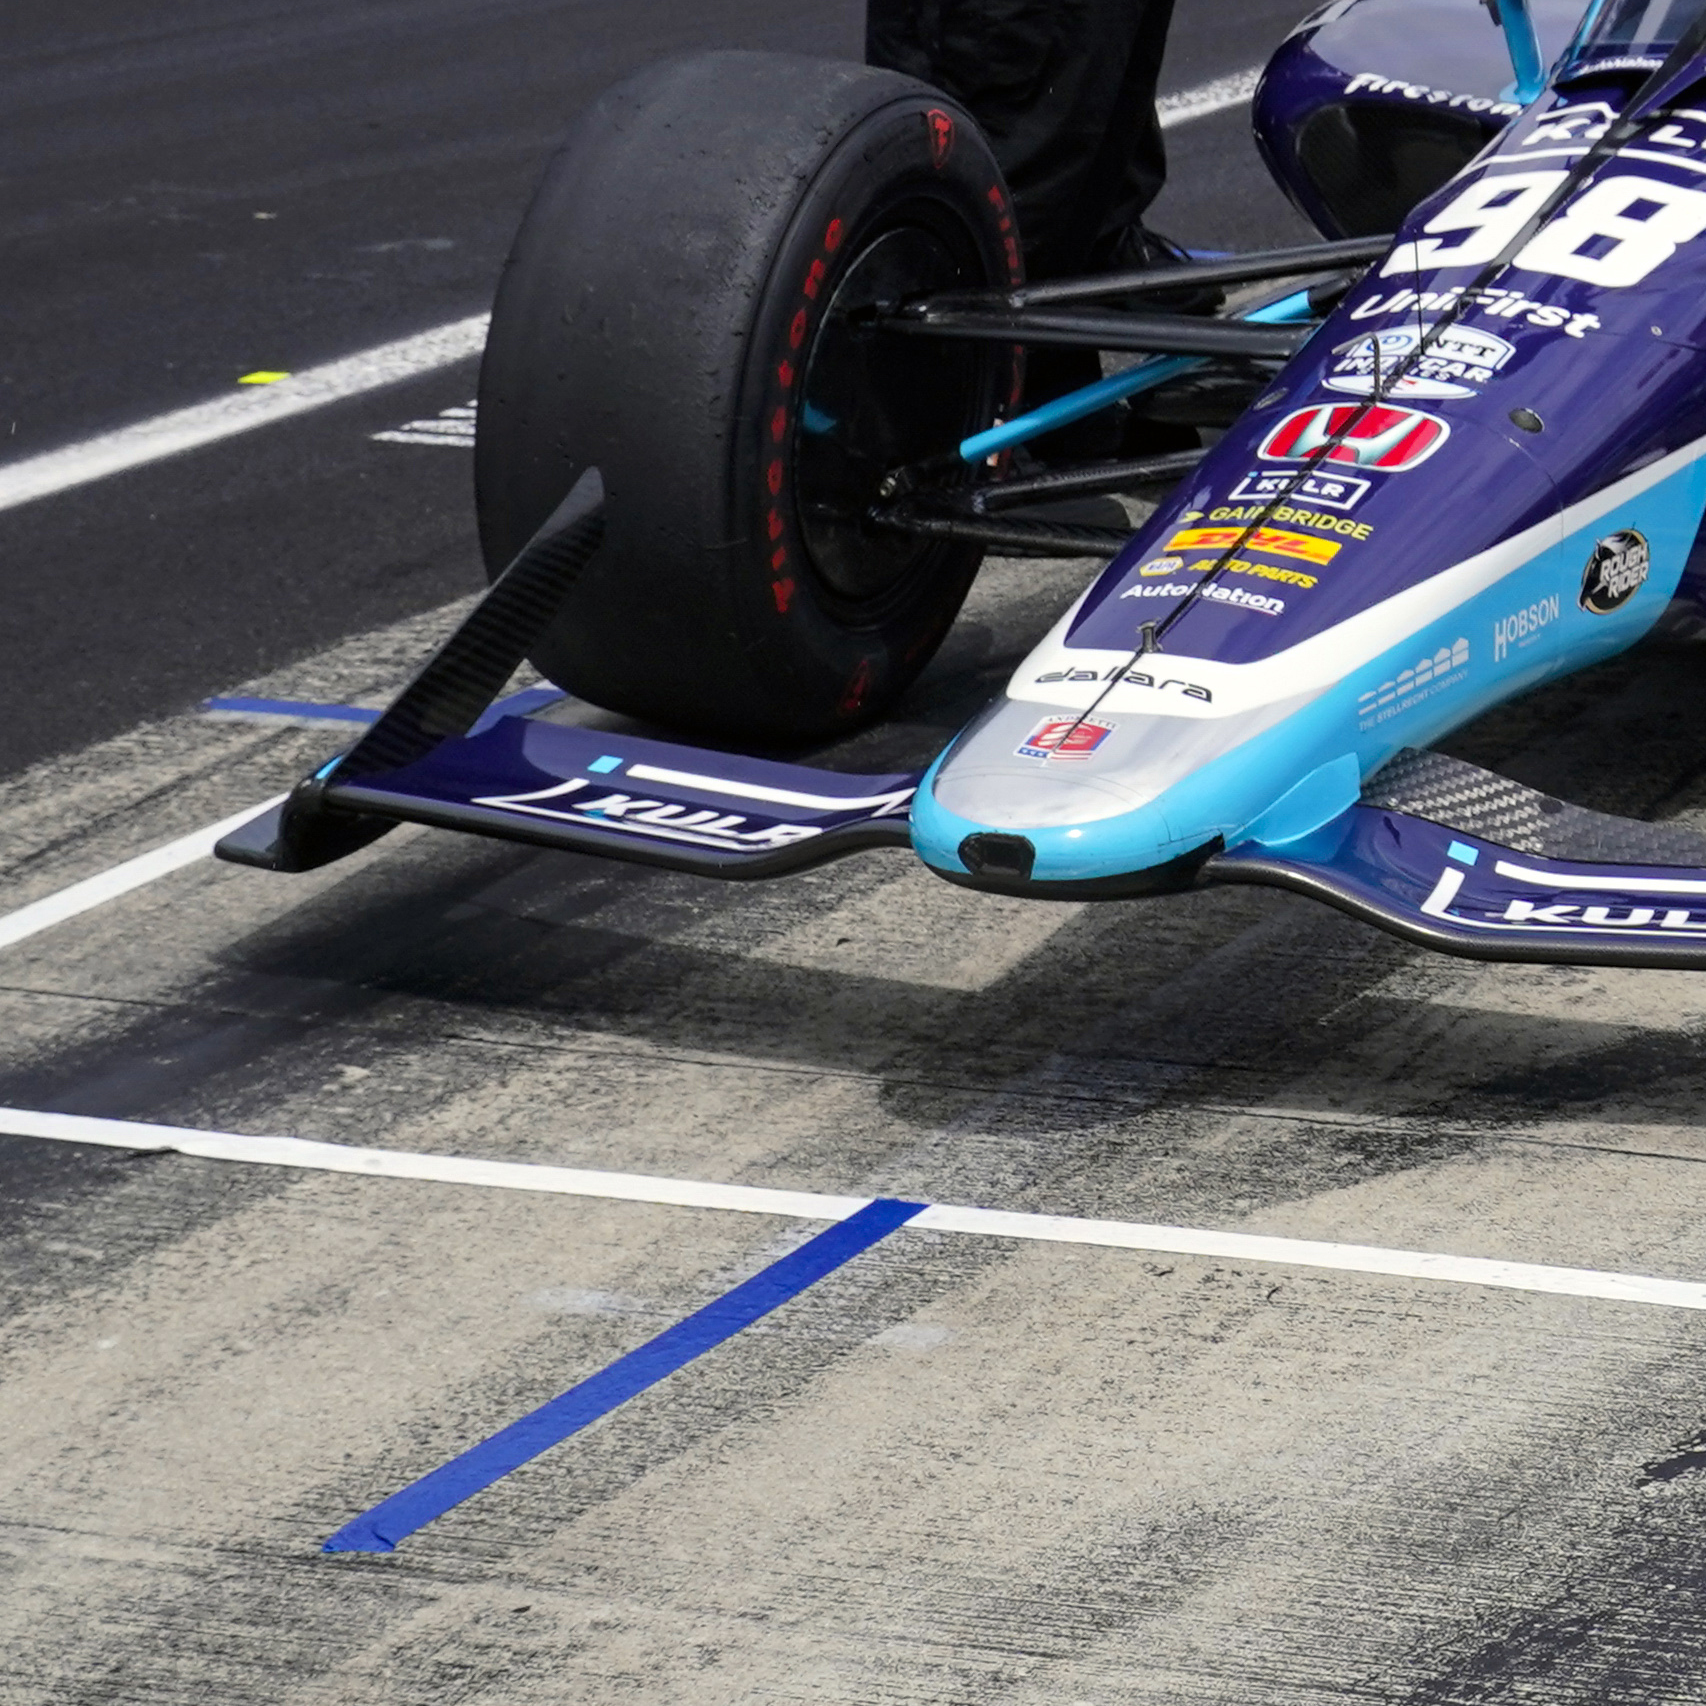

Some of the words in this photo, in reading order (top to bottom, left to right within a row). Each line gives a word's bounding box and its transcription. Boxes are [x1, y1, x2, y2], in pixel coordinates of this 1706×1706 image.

[1351, 285, 1601, 338] UniFirst
[1248, 564, 1319, 589] PARTS
[1600, 543, 1650, 580] ROUGH
[1608, 560, 1650, 598] RIDER
[1120, 581, 1286, 613] AutoNation
[1494, 594, 1560, 662] HOBSON
[575, 795, 823, 843] KULR
